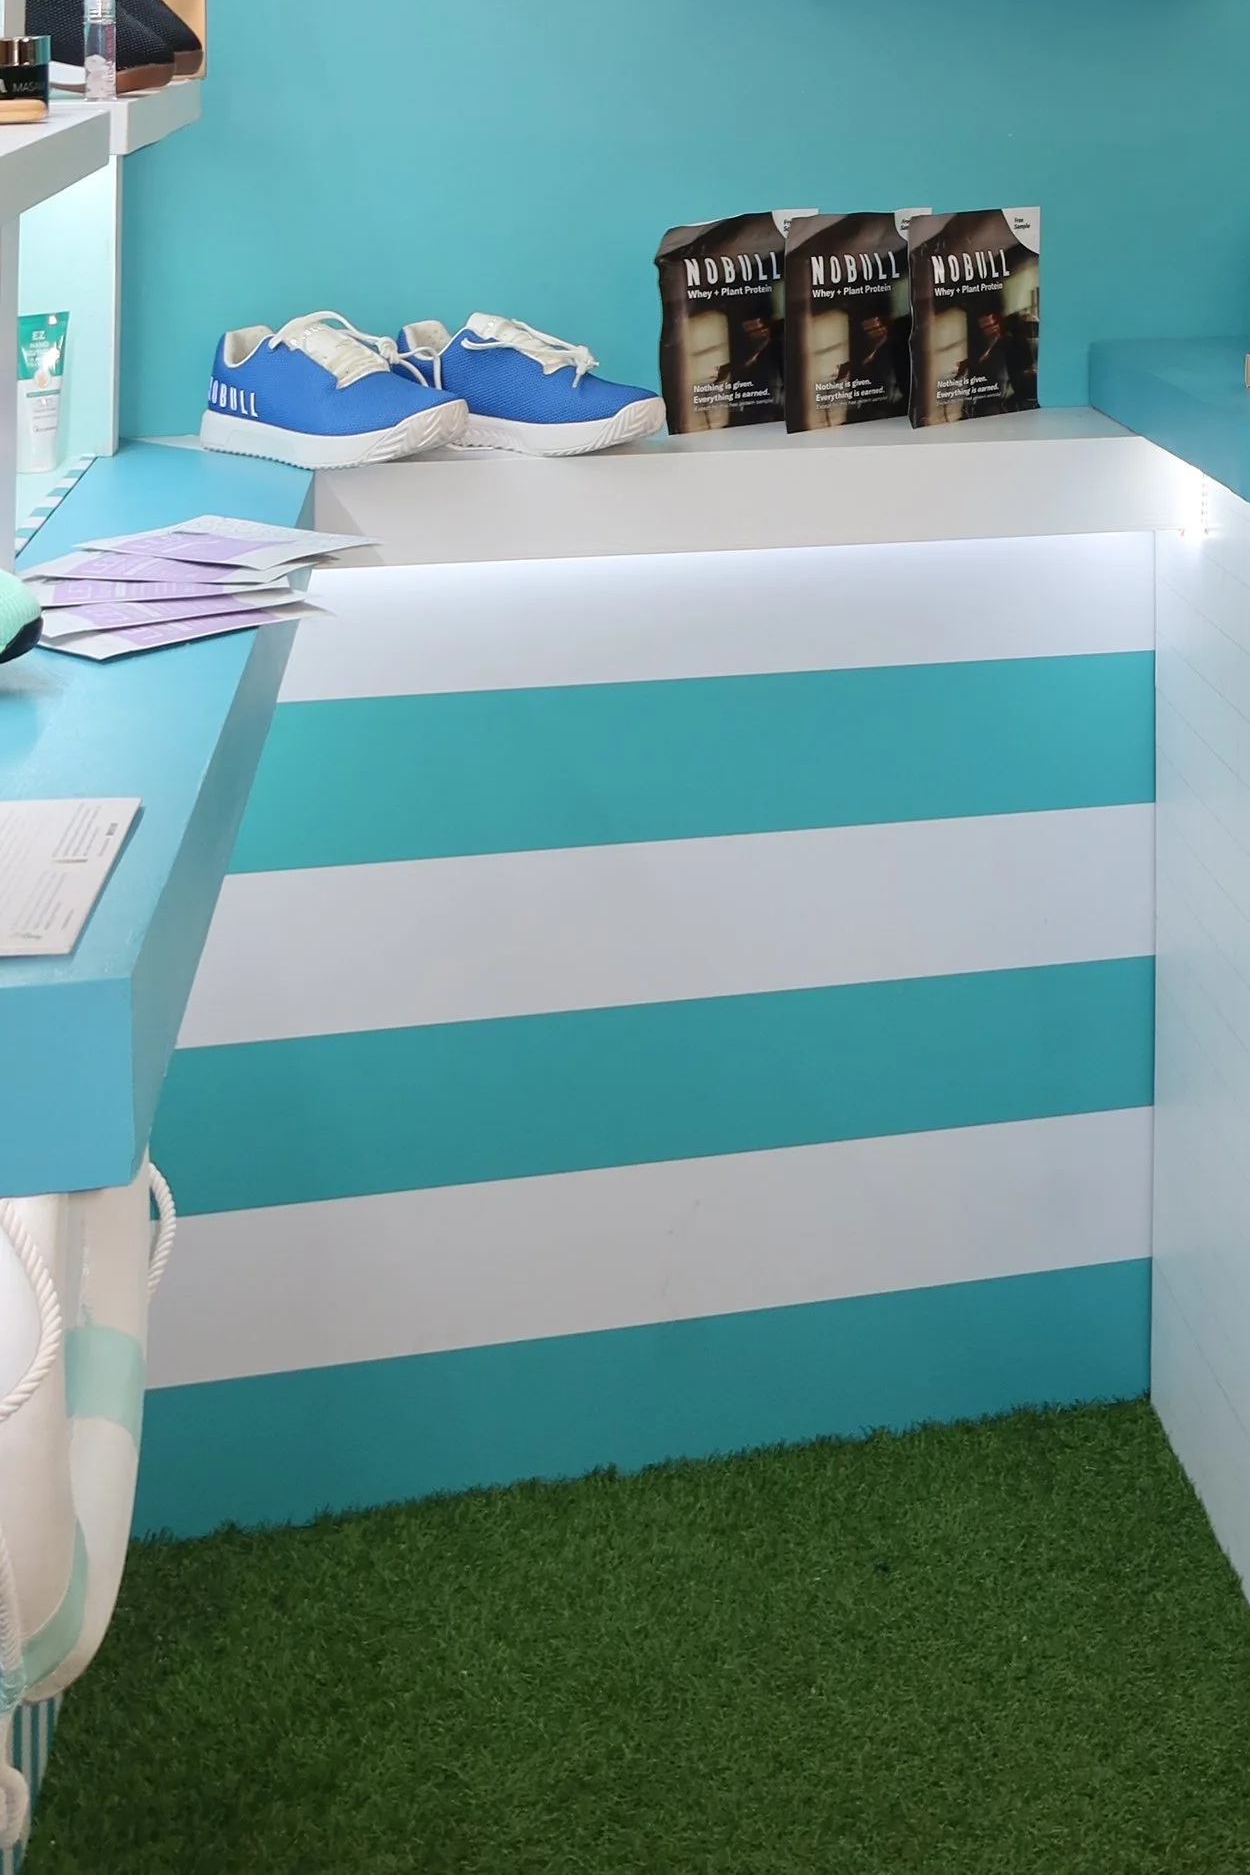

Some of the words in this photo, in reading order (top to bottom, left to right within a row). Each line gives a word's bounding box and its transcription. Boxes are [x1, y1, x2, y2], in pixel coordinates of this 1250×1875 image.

[684, 251, 781, 286] NOBULL
[810, 251, 900, 285] NOBULL
[931, 249, 1010, 284] NOBULL
[687, 289, 712, 300] Whey
[721, 286, 743, 296] Plant
[744, 284, 772, 294] Protein
[812, 289, 835, 299] Whey
[843, 286, 864, 296] Plant
[865, 284, 891, 293] Protein
[934, 287, 954, 297] Whey
[962, 284, 980, 294] Plant
[981, 282, 1003, 291] Protein
[693, 382, 724, 393] Nothing
[732, 380, 754, 391] given.
[815, 381, 844, 392] Nothing
[852, 378, 872, 388] given.
[937, 378, 963, 389] Nothing
[970, 376, 987, 386] given.
[693, 392, 733, 404] Everything
[742, 388, 770, 398] earned.
[815, 390, 853, 403] Everything
[861, 386, 885, 397] earned.
[936, 387, 971, 399] Everything
[978, 383, 999, 393] earned.
